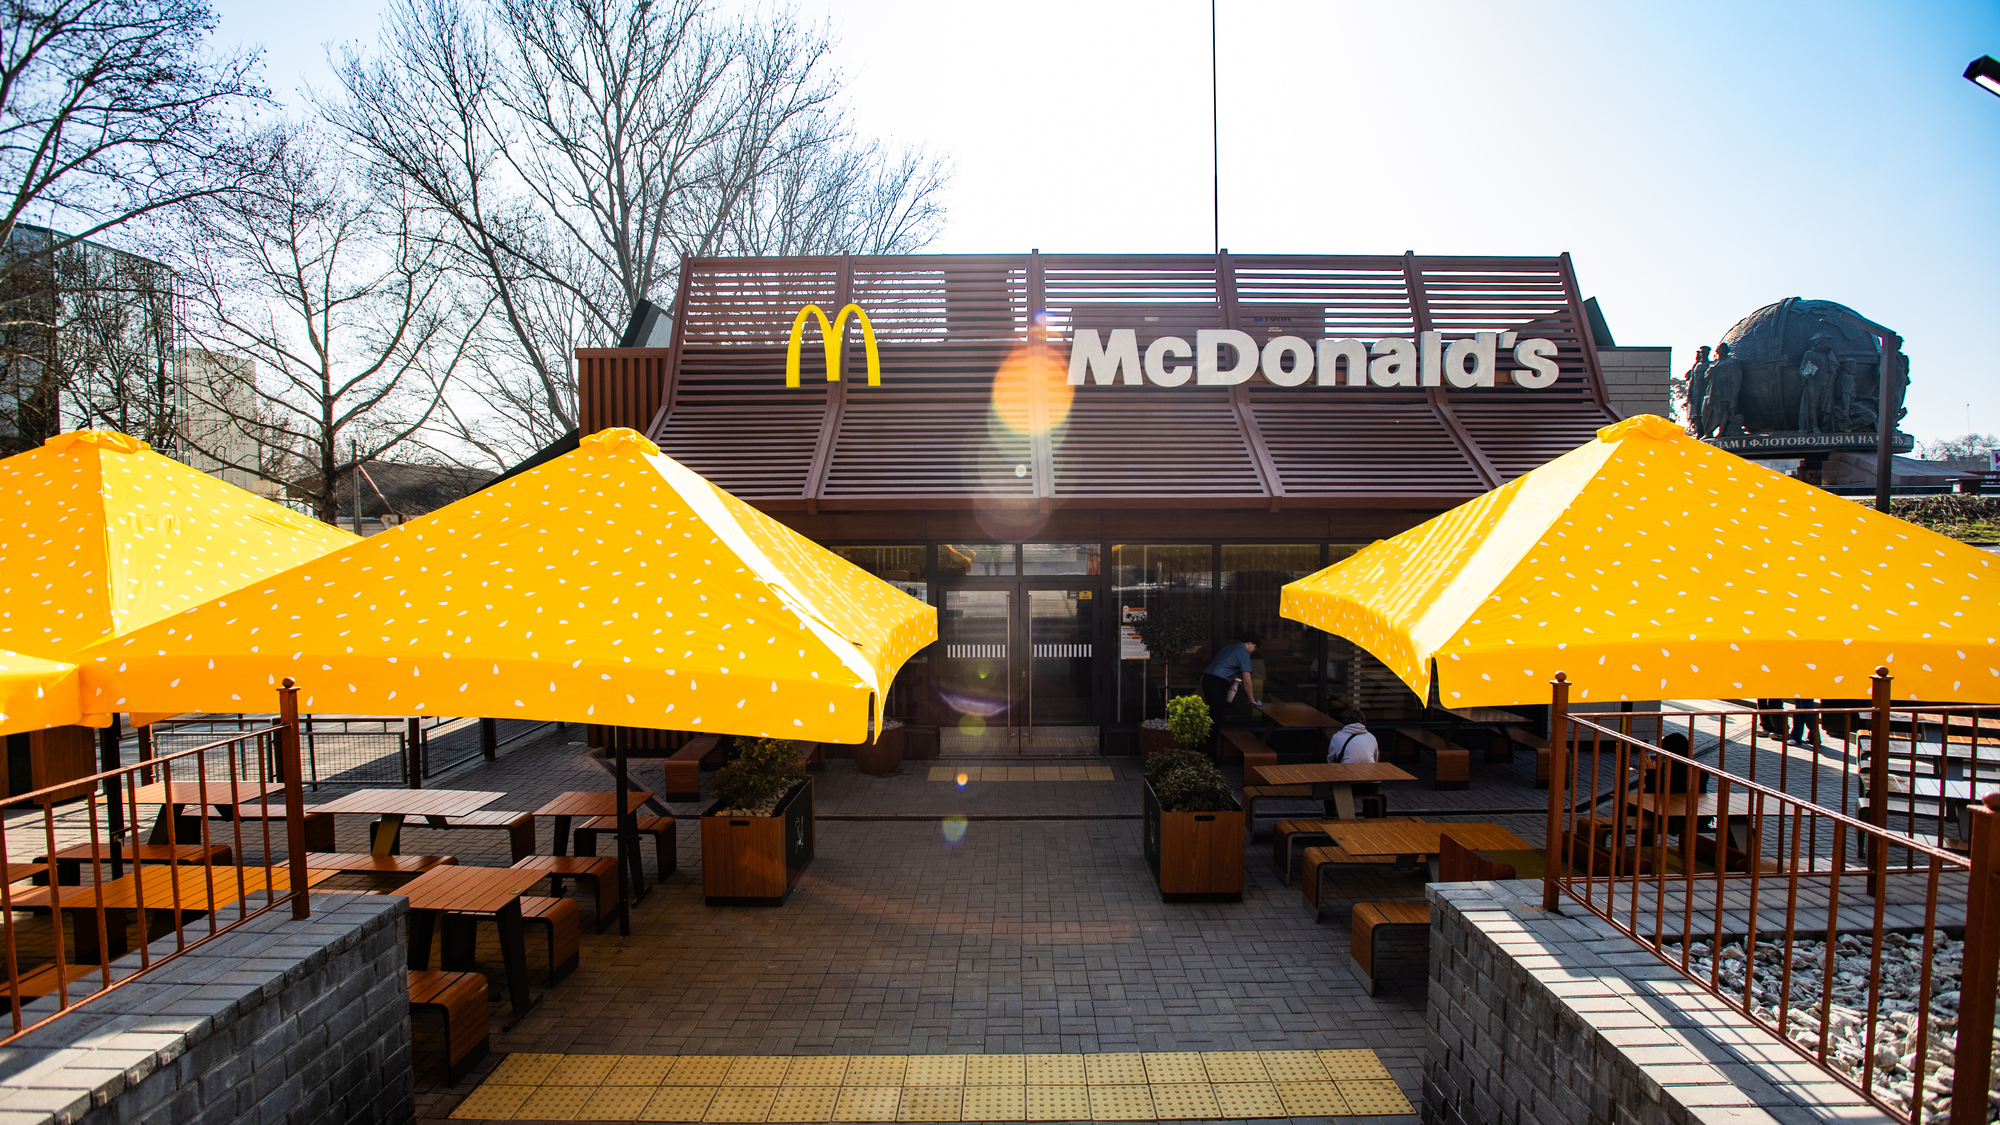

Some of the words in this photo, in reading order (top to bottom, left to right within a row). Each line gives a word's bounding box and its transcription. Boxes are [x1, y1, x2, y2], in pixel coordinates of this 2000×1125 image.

[1066, 328, 1560, 389] McDonald's
[1749, 435, 1855, 447] ФЛОТОВОДЦЯМ
[1858, 435, 1875, 444] НА
